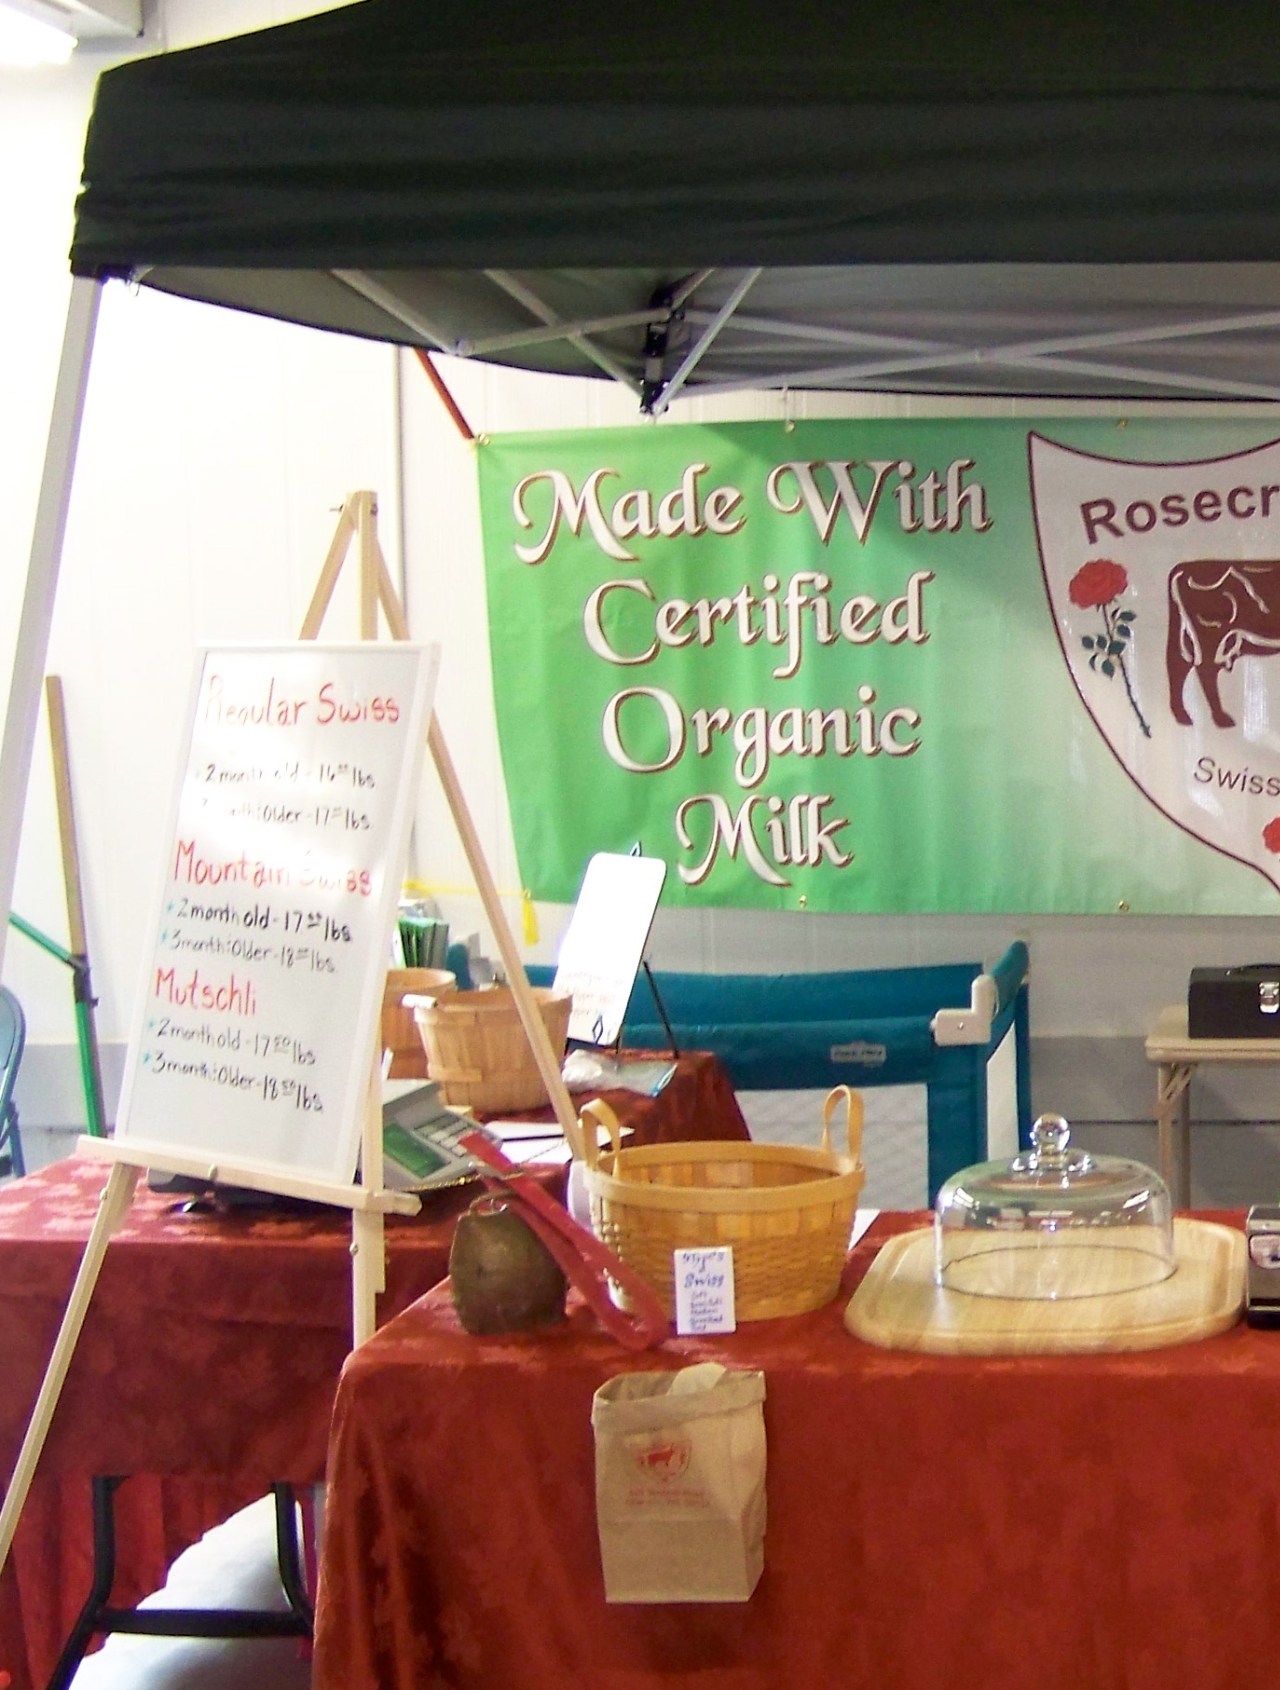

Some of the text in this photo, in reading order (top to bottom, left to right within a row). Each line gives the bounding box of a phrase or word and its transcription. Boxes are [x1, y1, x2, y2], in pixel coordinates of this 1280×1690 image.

[512, 460, 995, 566] Made With
[583, 571, 936, 679] Certified
[317, 681, 400, 727] Swiss
[603, 685, 922, 789] Organic
[1193, 756, 1280, 798] Swiss
[174, 839, 290, 890] Mountain
[675, 794, 854, 888] Milk
[242, 903, 270, 930] old
[324, 916, 354, 943] lbs
[156, 966, 257, 1017] Mutschli
[217, 1026, 241, 1051] old
[292, 1040, 317, 1065] lbs
[296, 1083, 324, 1112] lbs
